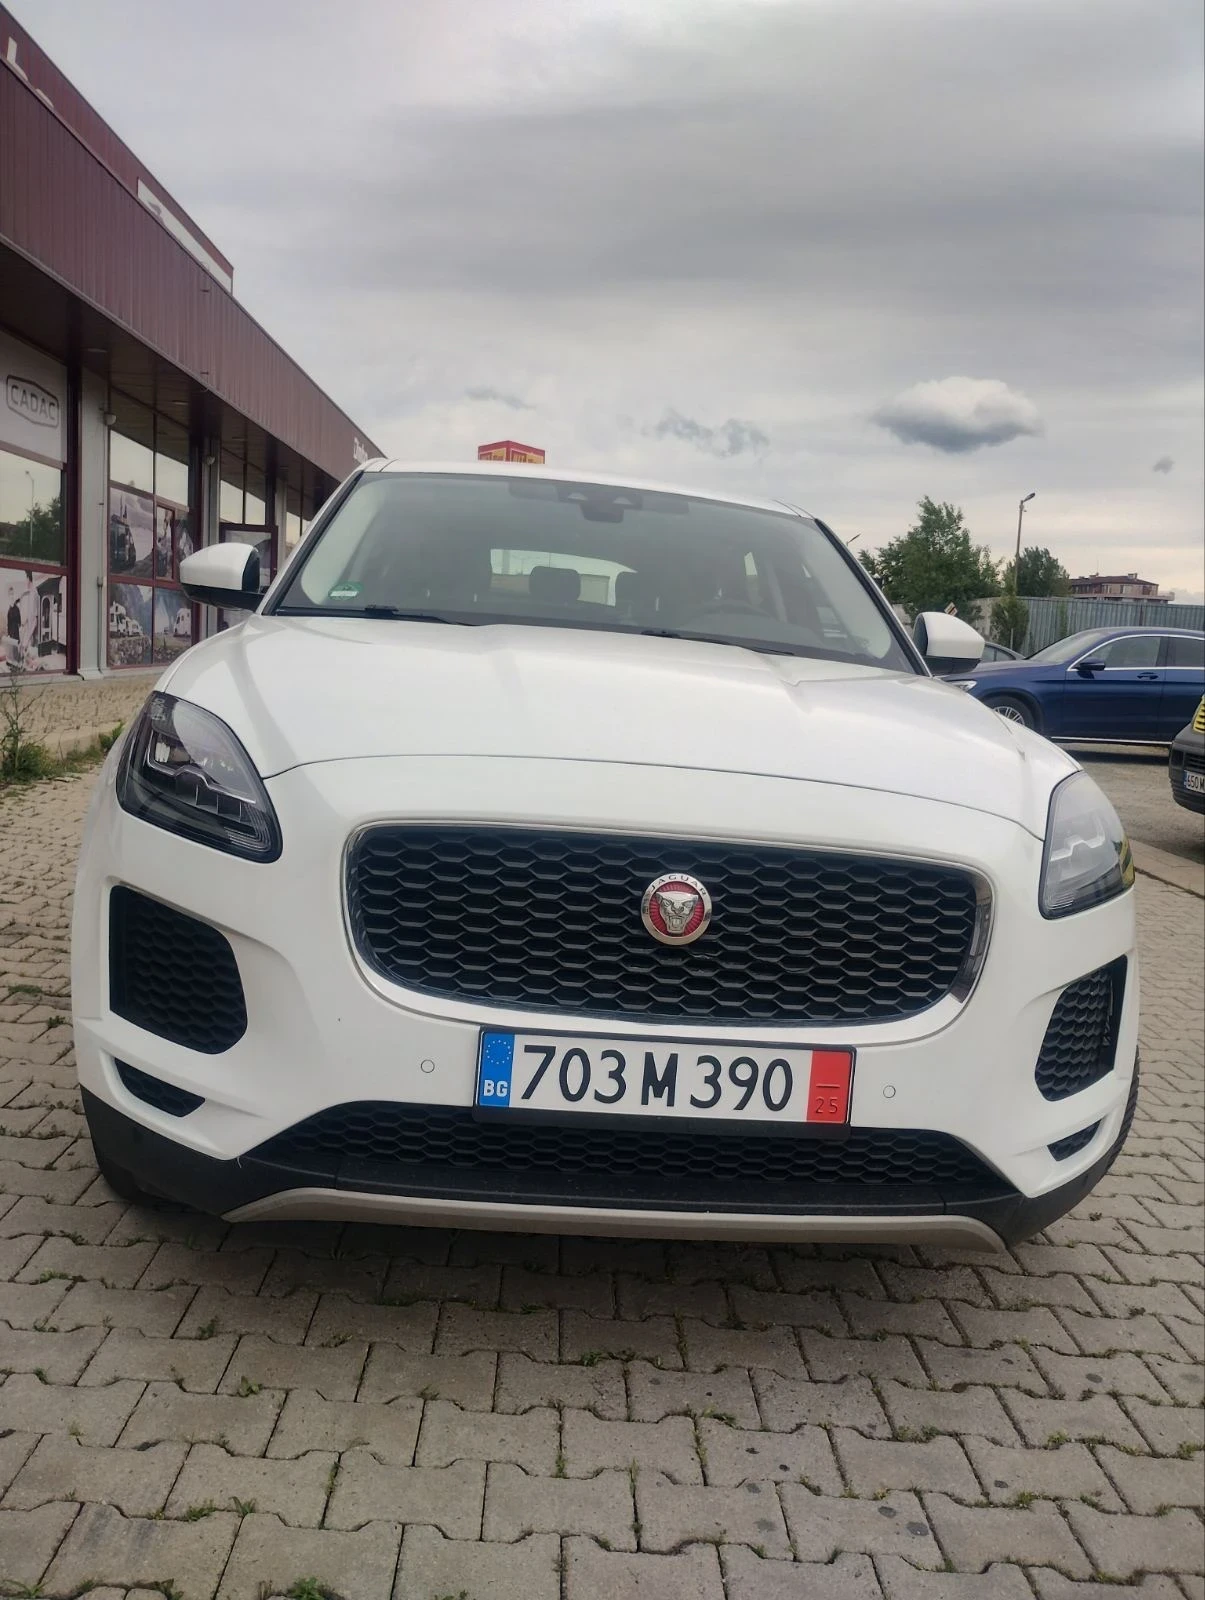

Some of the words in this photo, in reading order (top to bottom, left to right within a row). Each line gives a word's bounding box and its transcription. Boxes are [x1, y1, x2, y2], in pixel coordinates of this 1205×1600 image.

[10, 384, 56, 421] CADAC
[651, 874, 707, 896] JAGUAR
[484, 1079, 508, 1098] BG
[520, 1044, 627, 1103] 703
[640, 1051, 679, 1107] M
[690, 1054, 793, 1112] 390
[815, 1095, 838, 1114] 25
